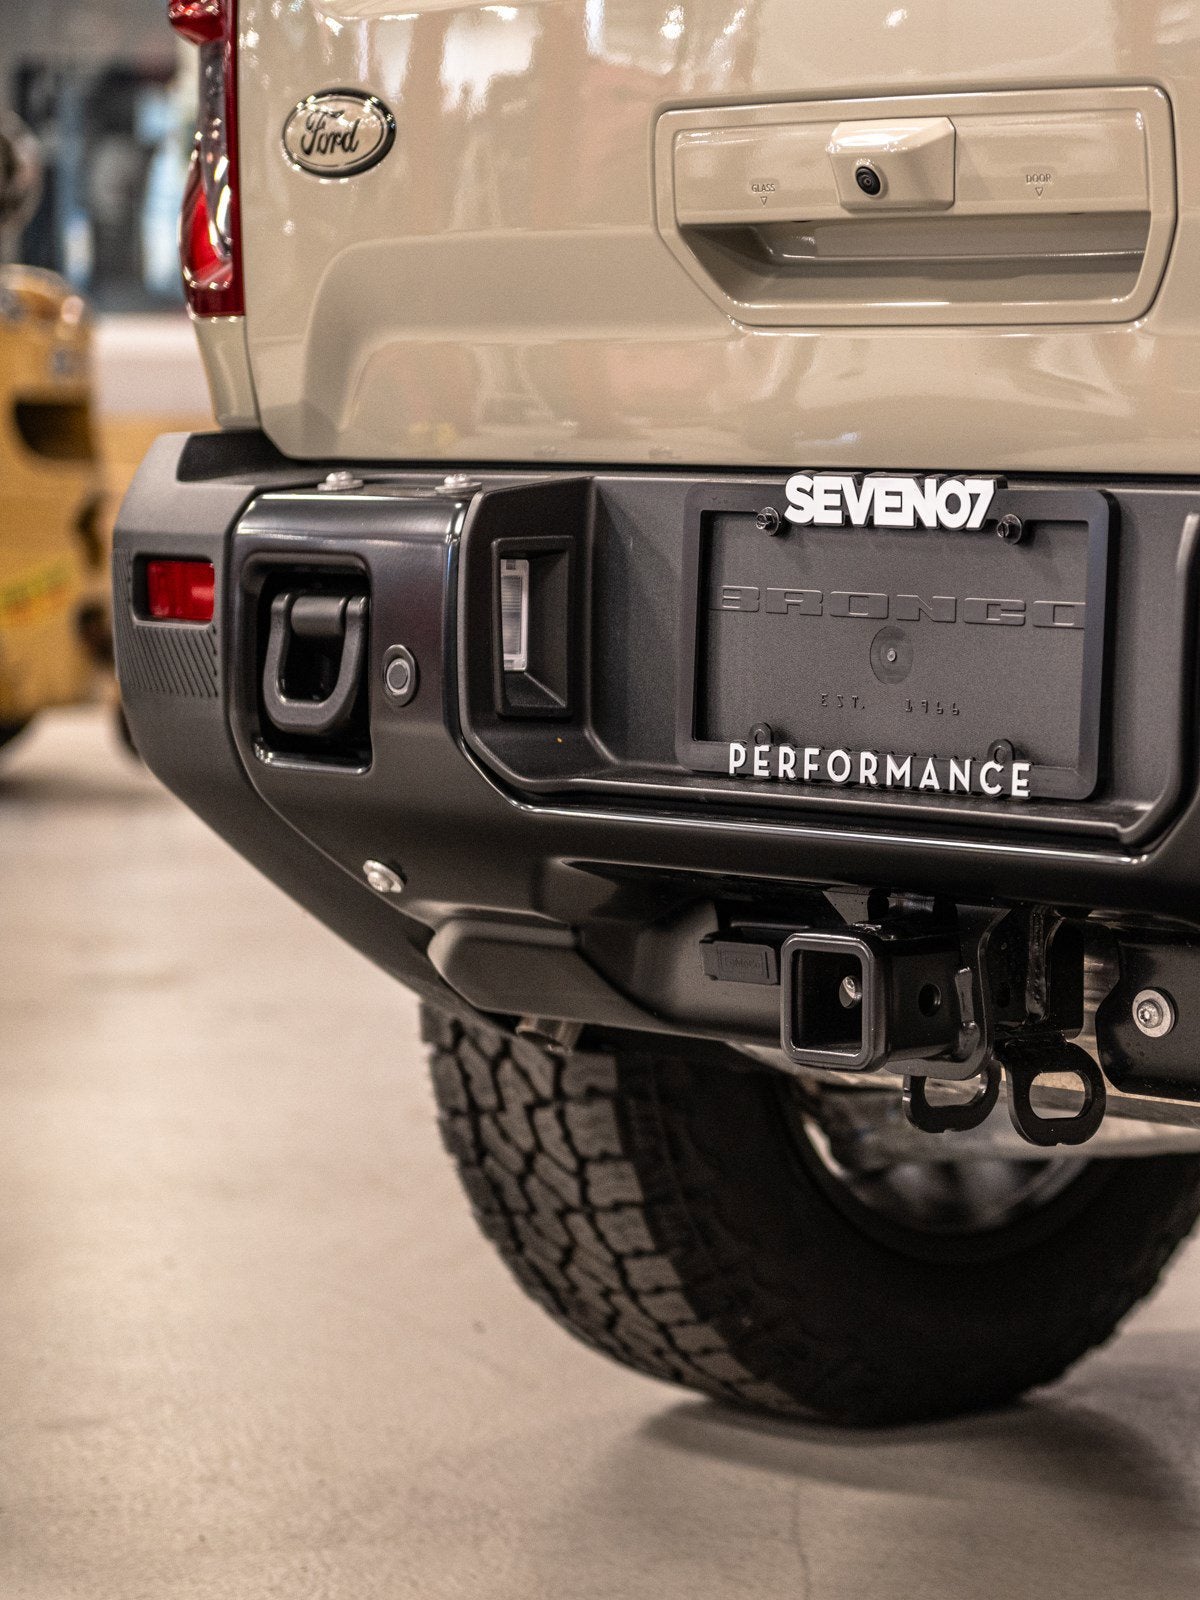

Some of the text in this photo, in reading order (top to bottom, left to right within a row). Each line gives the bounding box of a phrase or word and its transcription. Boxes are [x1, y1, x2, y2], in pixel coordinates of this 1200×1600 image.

[301, 109, 360, 155] Ford
[751, 183, 776, 192] GLASS
[1026, 173, 1051, 183] DOOR
[709, 585, 1086, 629] BRONCO
[821, 693, 960, 716] EST. 1966
[728, 742, 1032, 798] PERFORMANCE
